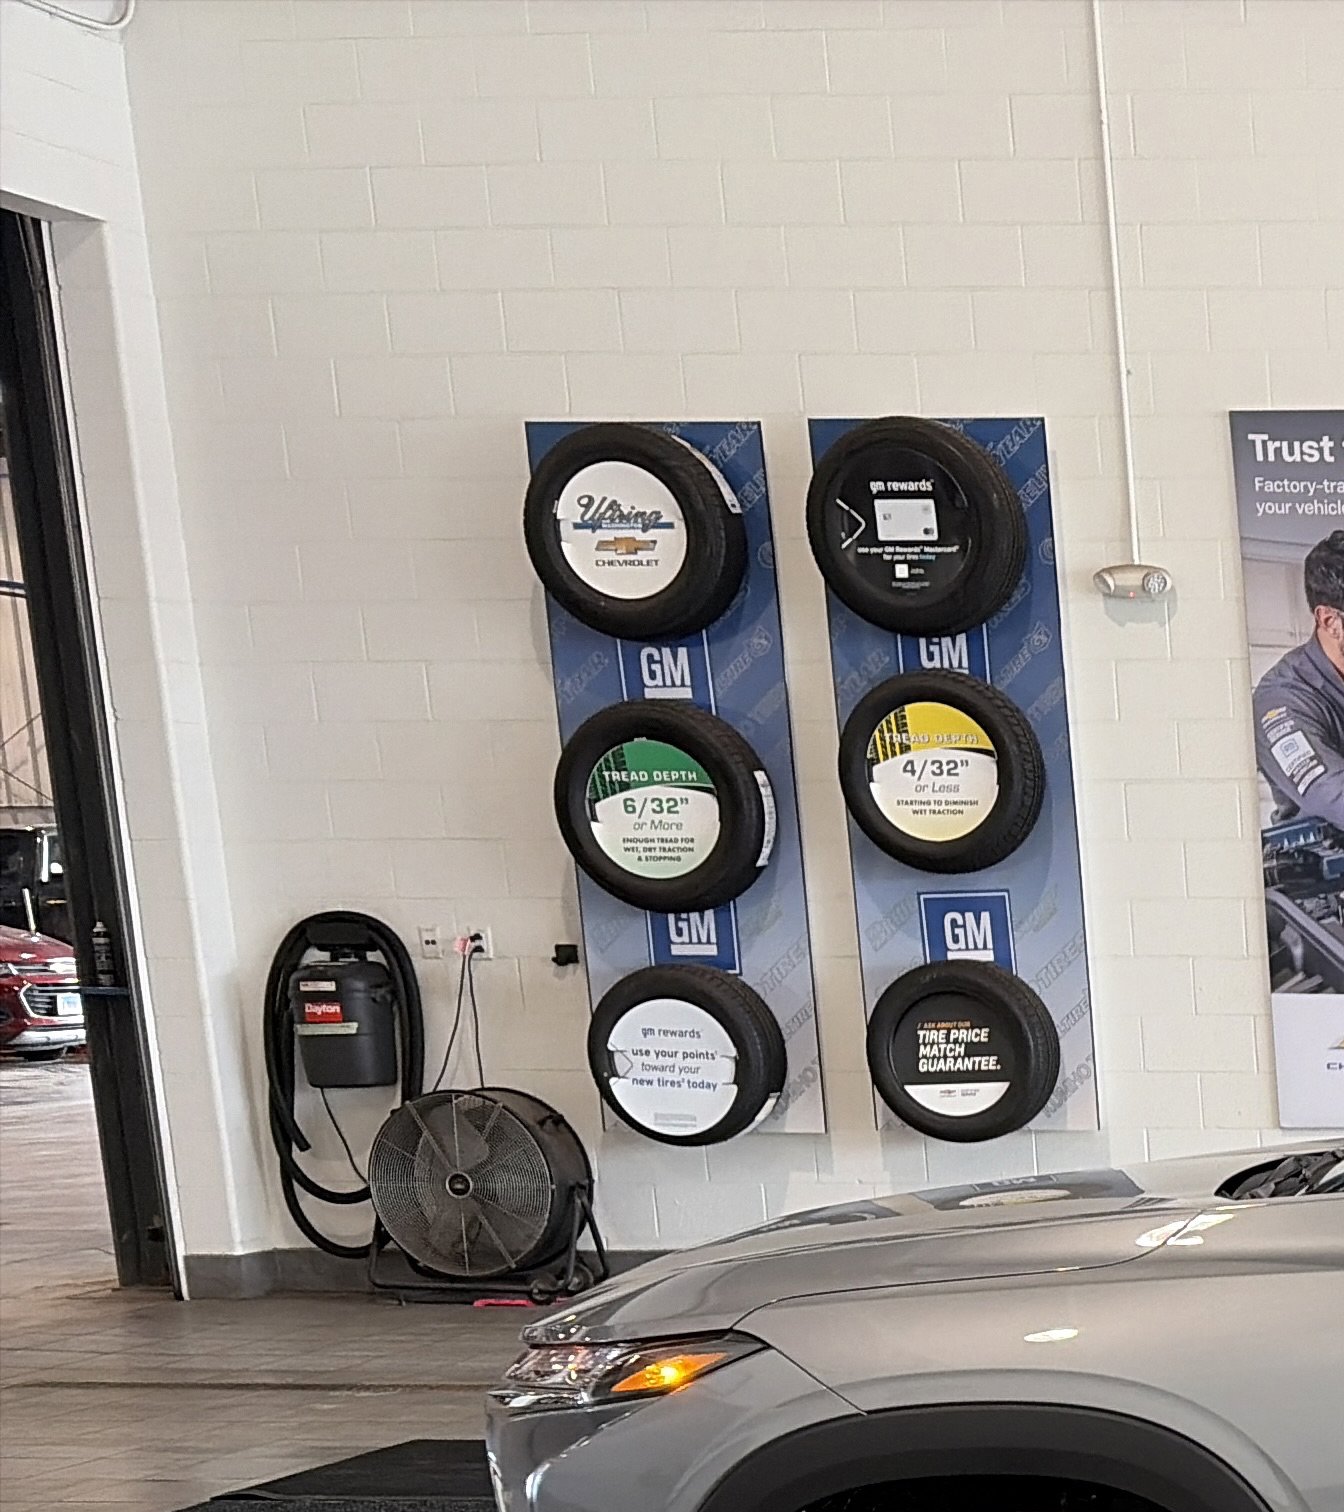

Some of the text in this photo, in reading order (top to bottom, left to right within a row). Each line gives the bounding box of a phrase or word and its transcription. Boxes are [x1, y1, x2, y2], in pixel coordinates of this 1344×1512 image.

[1248, 433, 1335, 462] Trust
[1256, 501, 1292, 516] your
[919, 633, 968, 669] GM
[640, 646, 690, 688] GM
[883, 733, 979, 743] TREAD DEPTH
[603, 771, 697, 782] TREAD DEPTH
[915, 782, 959, 793] or Less
[633, 820, 683, 831] or More
[667, 910, 716, 943] GM
[943, 911, 993, 951] GM
[305, 1002, 341, 1016] Dayton
[641, 1028, 701, 1039] gm rewards
[917, 1028, 989, 1043] TIRE PRICE
[632, 1048, 679, 1059] use your
[919, 1044, 965, 1057] MATCH
[641, 1063, 701, 1075] toward your
[918, 1056, 1001, 1073] GUARANTEE.
[632, 1078, 717, 1091] new today
